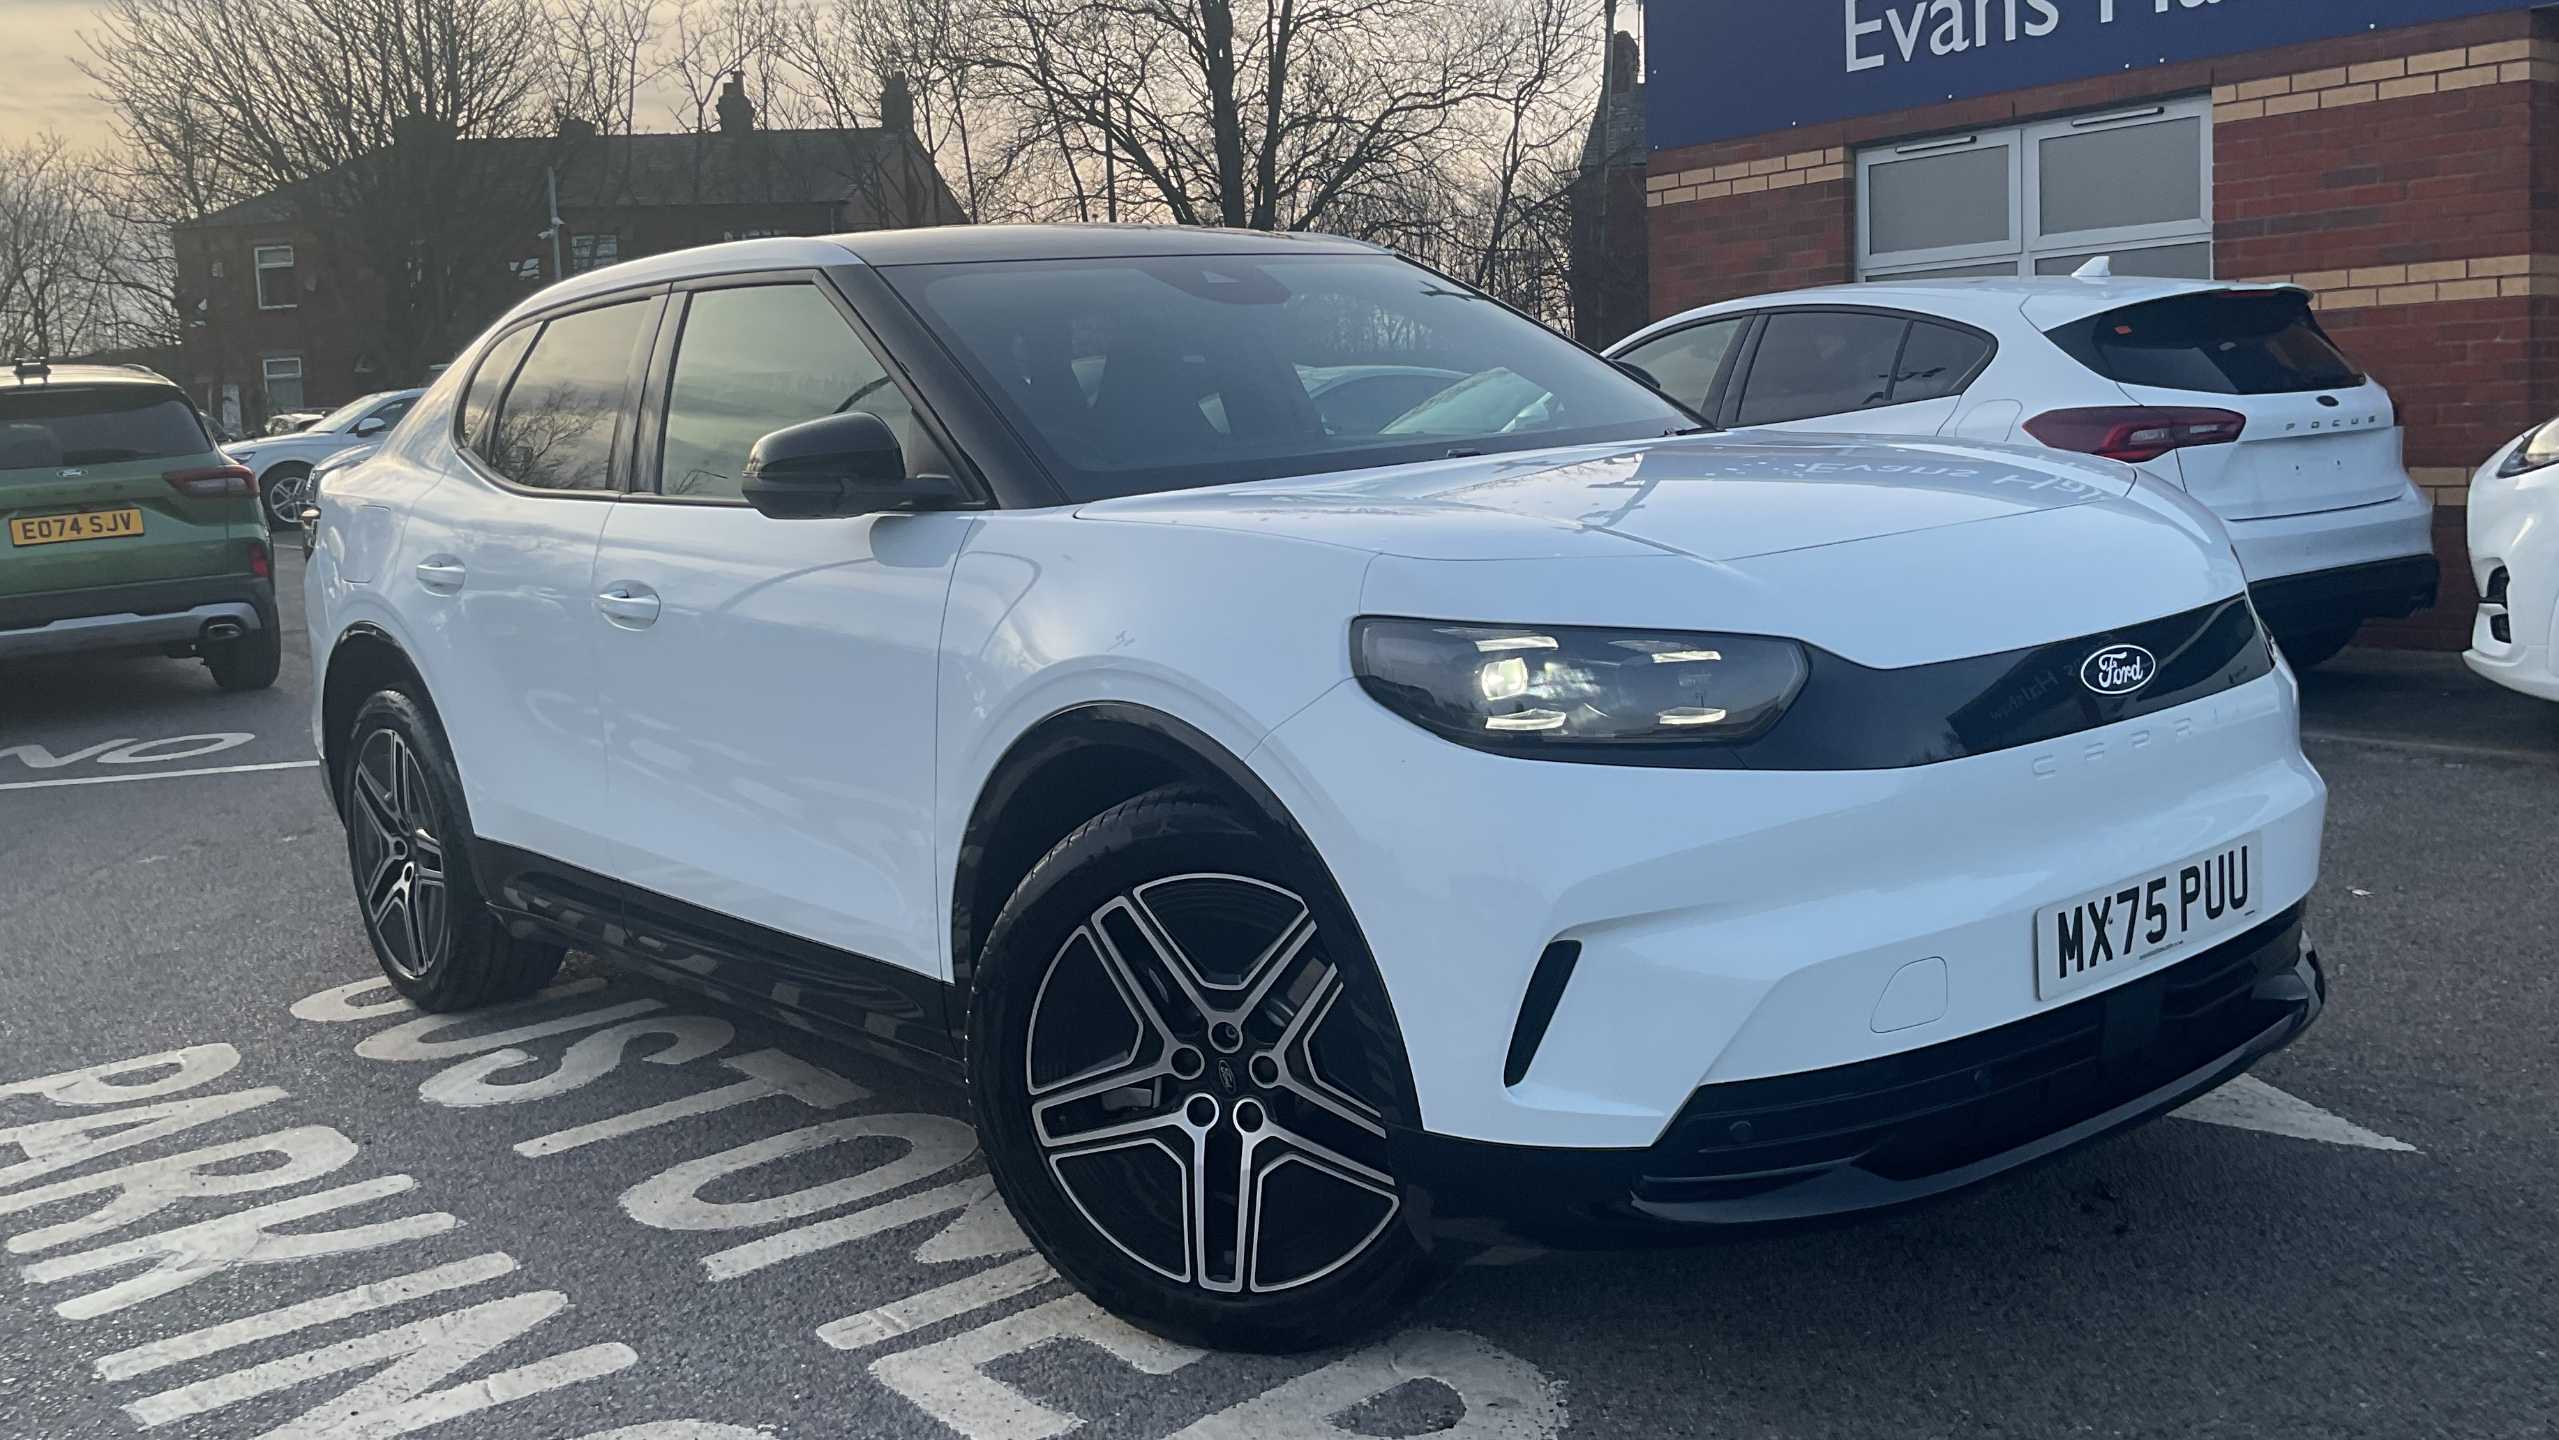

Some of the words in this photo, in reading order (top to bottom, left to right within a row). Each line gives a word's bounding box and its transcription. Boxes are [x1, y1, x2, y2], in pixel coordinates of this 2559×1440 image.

[1845, 0, 2059, 73] Evans
[2285, 415, 2375, 431] FOCUS
[89, 512, 131, 533] SJV
[2057, 876, 2168, 979] MX75
[2180, 845, 2248, 932] PUU
[0, 1043, 772, 1440] PARKIN
